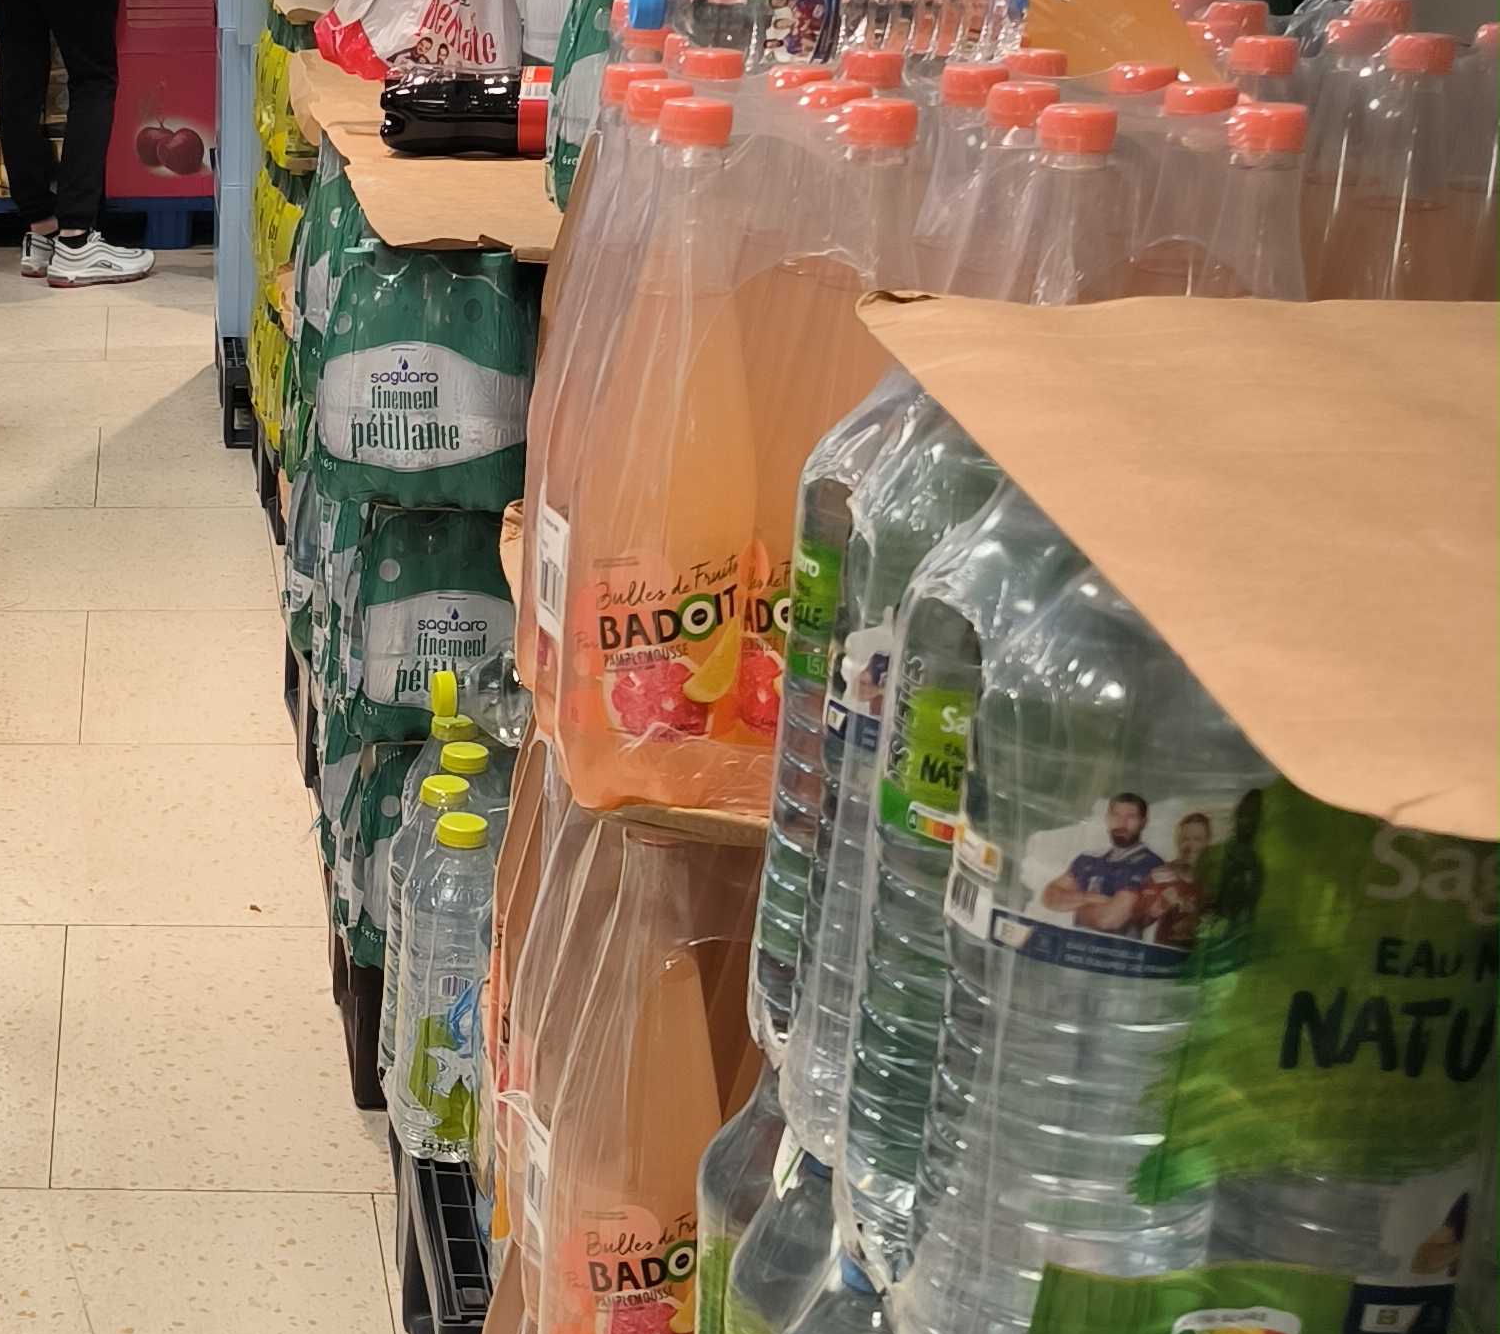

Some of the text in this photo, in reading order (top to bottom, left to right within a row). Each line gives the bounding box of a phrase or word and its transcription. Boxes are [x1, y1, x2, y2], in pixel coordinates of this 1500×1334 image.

[370, 371, 439, 385] saguaro
[371, 385, 440, 409] finement
[350, 411, 460, 458] pétillante
[594, 580, 666, 610] Bulles
[671, 575, 690, 595] de
[417, 619, 488, 634] saguaro
[598, 584, 738, 651] BADOIT
[417, 632, 487, 657] finement
[1279, 986, 1498, 1083] NATU
[583, 1231, 654, 1256] Bulles
[658, 1226, 676, 1245] de
